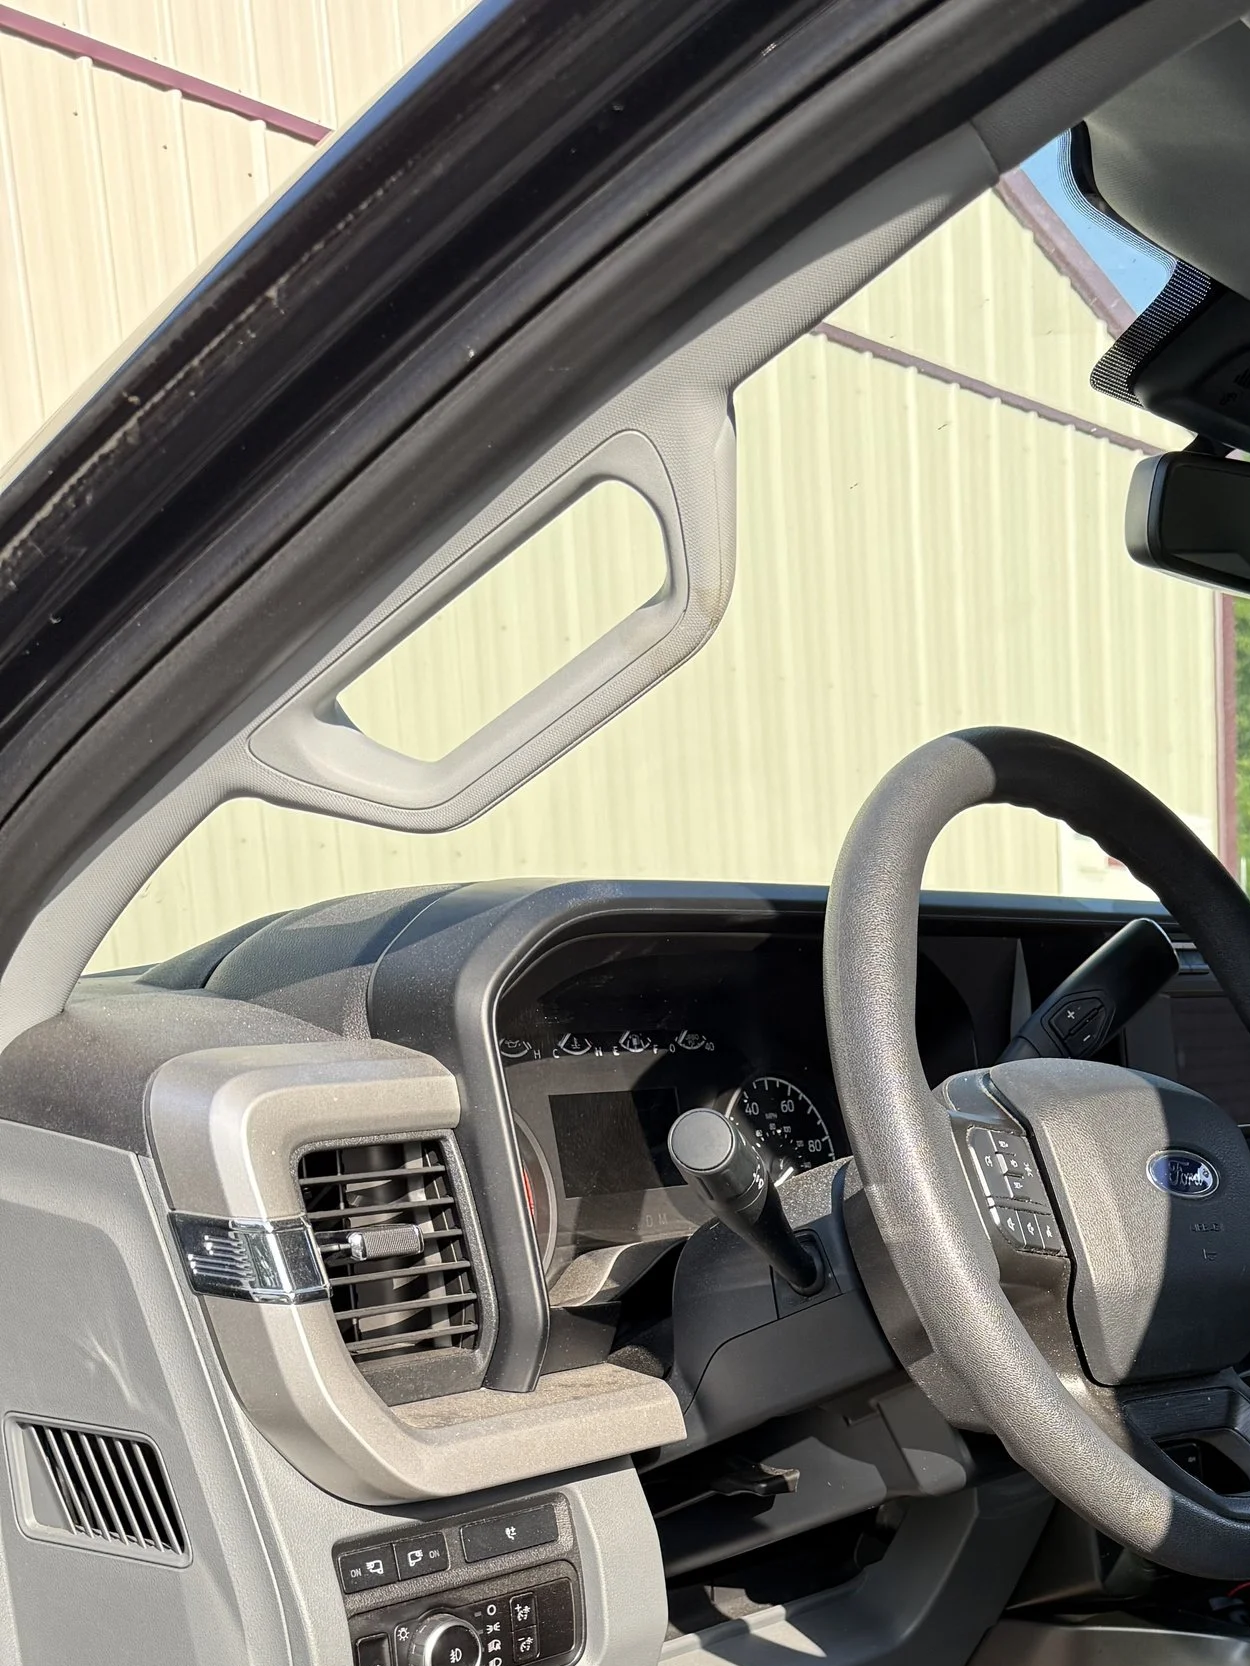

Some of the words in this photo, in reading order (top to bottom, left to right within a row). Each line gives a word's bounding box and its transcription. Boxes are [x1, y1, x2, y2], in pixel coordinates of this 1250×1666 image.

[744, 1101, 760, 1116] 40
[780, 1099, 795, 1113] 60
[807, 1139, 823, 1153] 80
[1168, 1160, 1204, 1187] Ford
[429, 1548, 440, 1559] ON
[350, 1567, 362, 1578] ON
